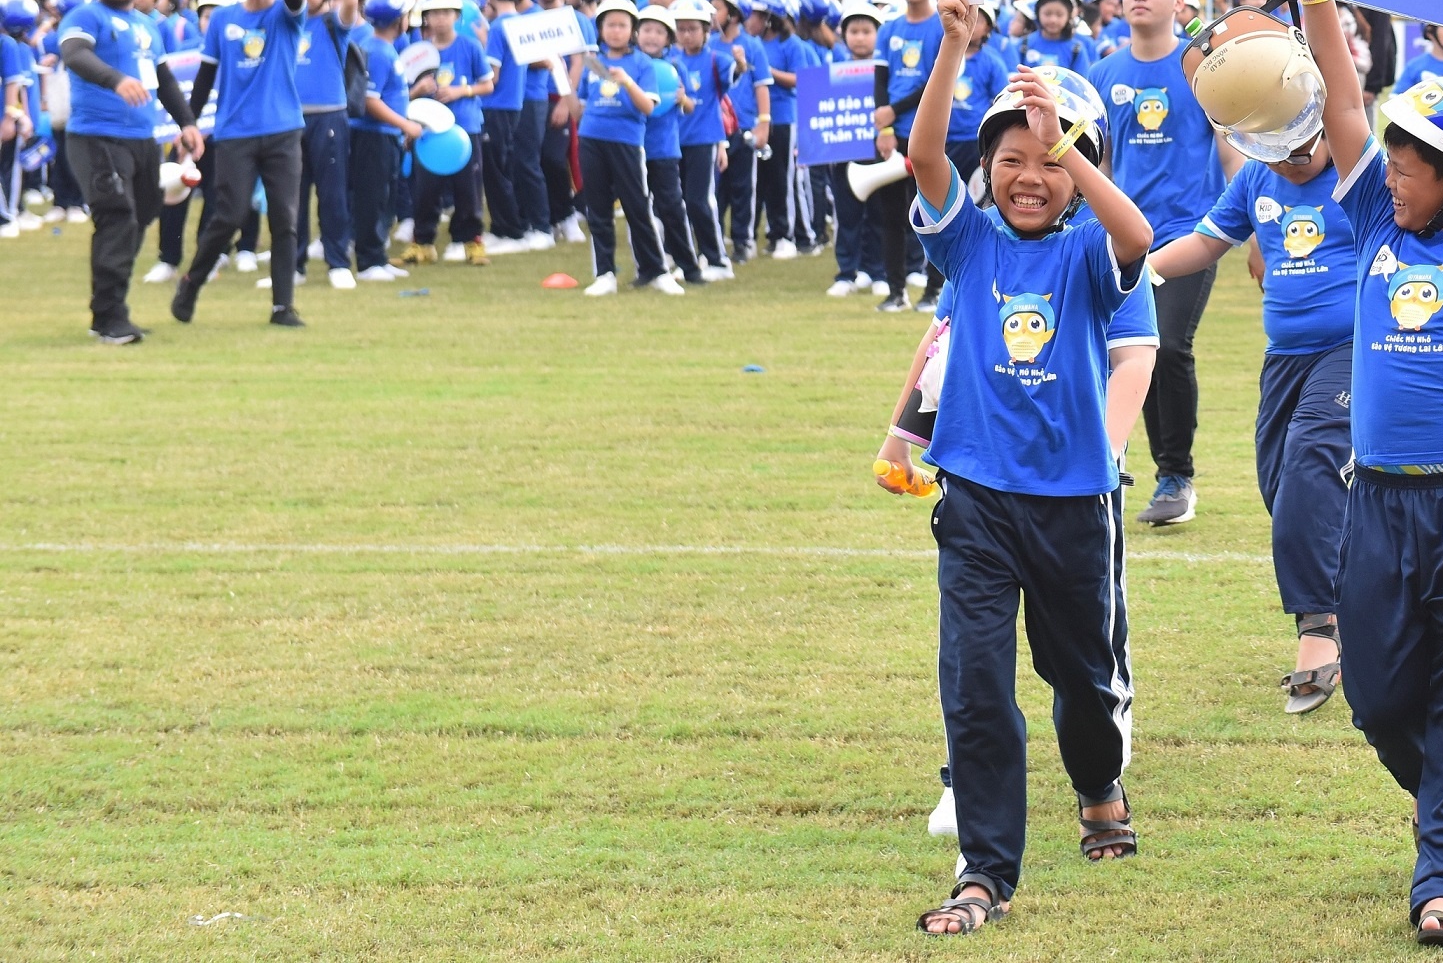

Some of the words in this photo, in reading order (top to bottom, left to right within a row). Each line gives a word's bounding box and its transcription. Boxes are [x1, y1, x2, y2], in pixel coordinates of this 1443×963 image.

[1209, 56, 1227, 73] HEAD
[1259, 204, 1273, 212] KID
[1385, 333, 1404, 343] Chiếc
[1405, 335, 1416, 343] Mũ
[1416, 334, 1432, 343] Nhỏ
[1383, 342, 1393, 353] Vệ
[1394, 343, 1417, 353] Tương
[1418, 344, 1431, 353] Lai
[994, 363, 1006, 374] Bảo
